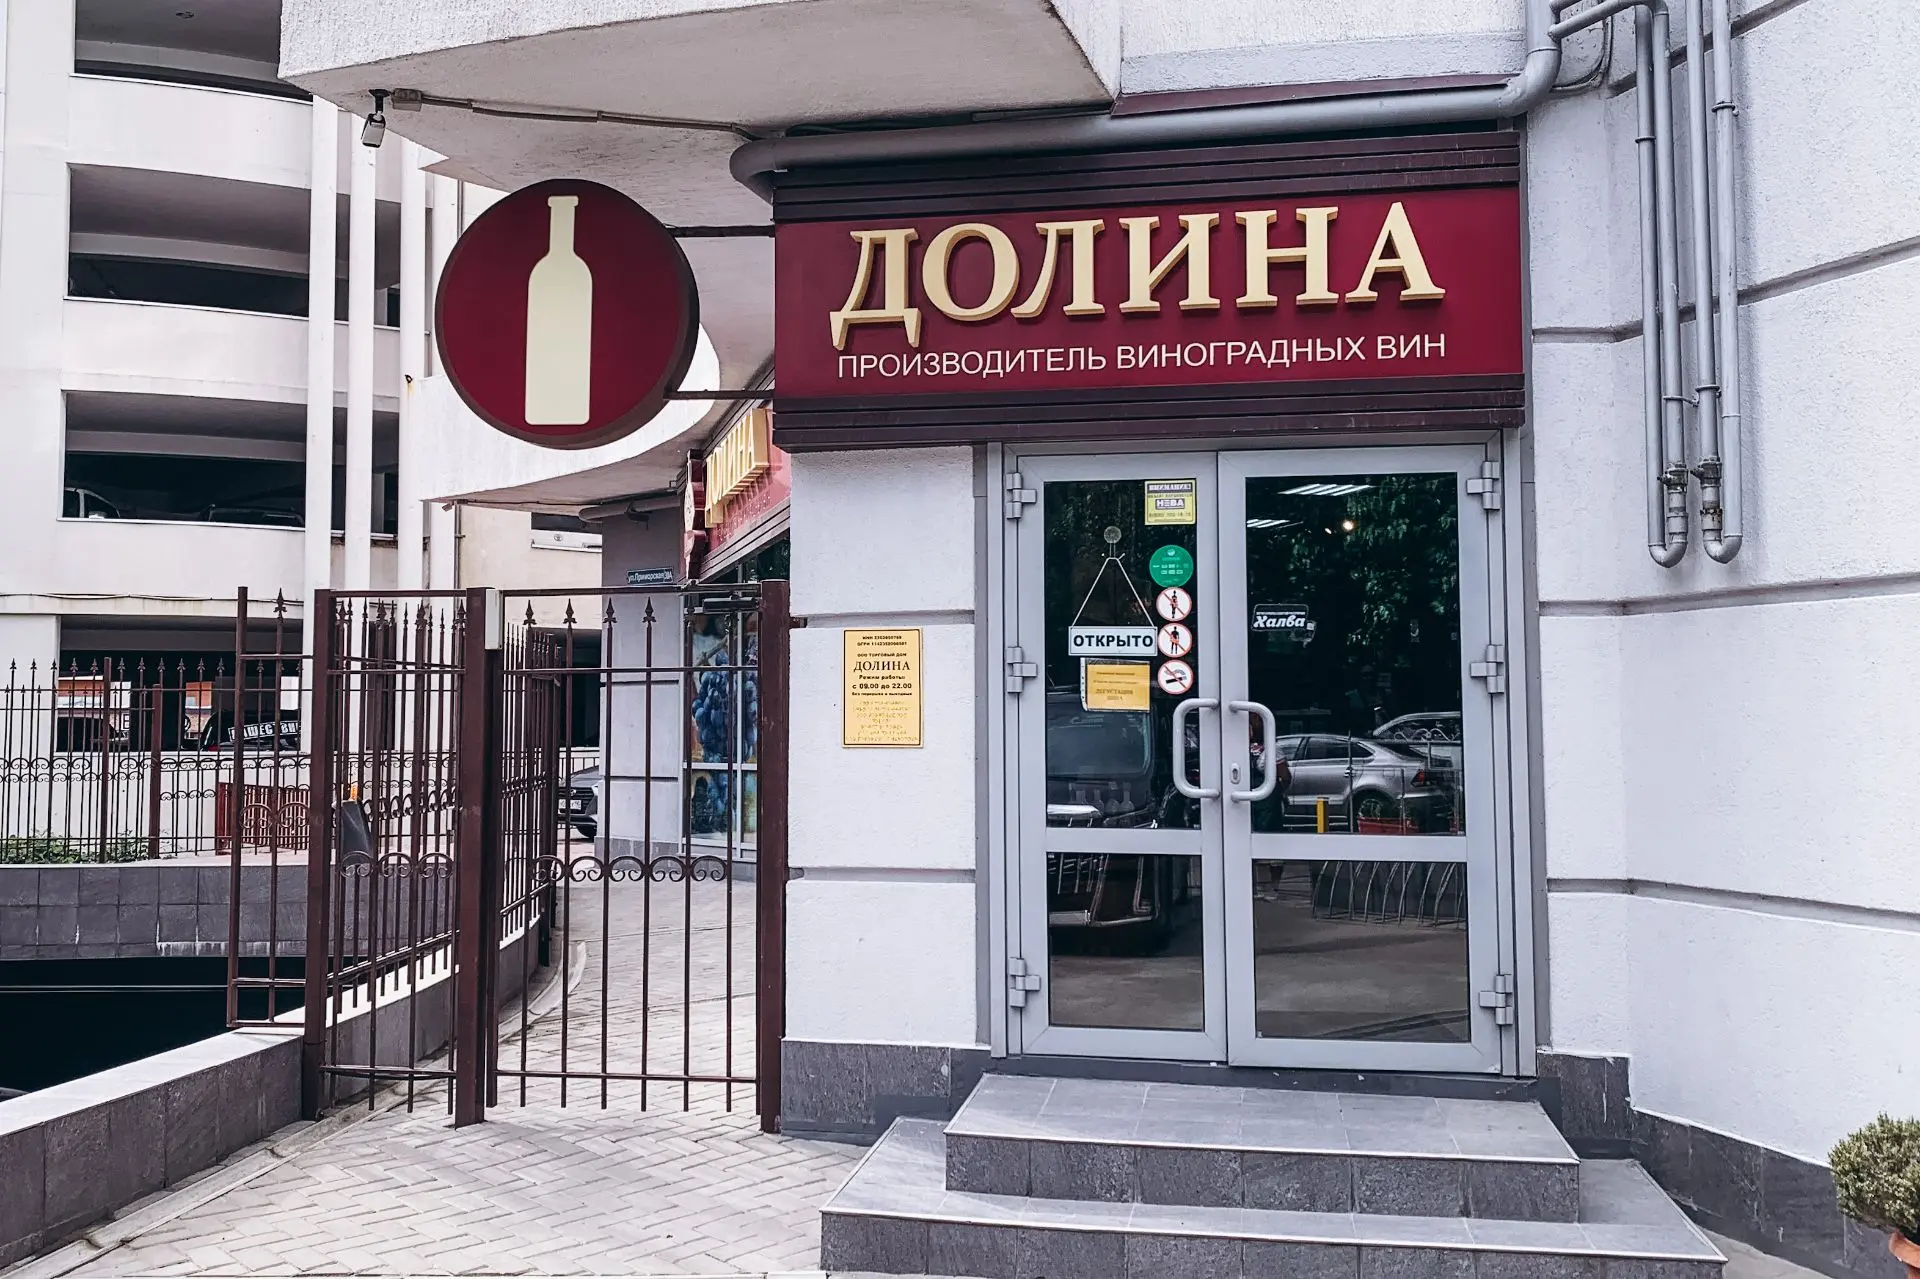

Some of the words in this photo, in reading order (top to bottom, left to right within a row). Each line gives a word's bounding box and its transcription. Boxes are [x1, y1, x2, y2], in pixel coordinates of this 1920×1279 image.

[829, 202, 1447, 351] ДОЛИНА
[838, 347, 1106, 379] ПРОИЗВОДИТЕЛЬ
[1117, 336, 1366, 369] ВИНОГРАДНЫХ
[1376, 333, 1446, 360] ВИН
[1156, 499, 1184, 508] НЕВА
[1253, 614, 1306, 628] Халва
[1073, 633, 1154, 649] ОТКРЫТО
[853, 660, 911, 673] ДОЛИНА
